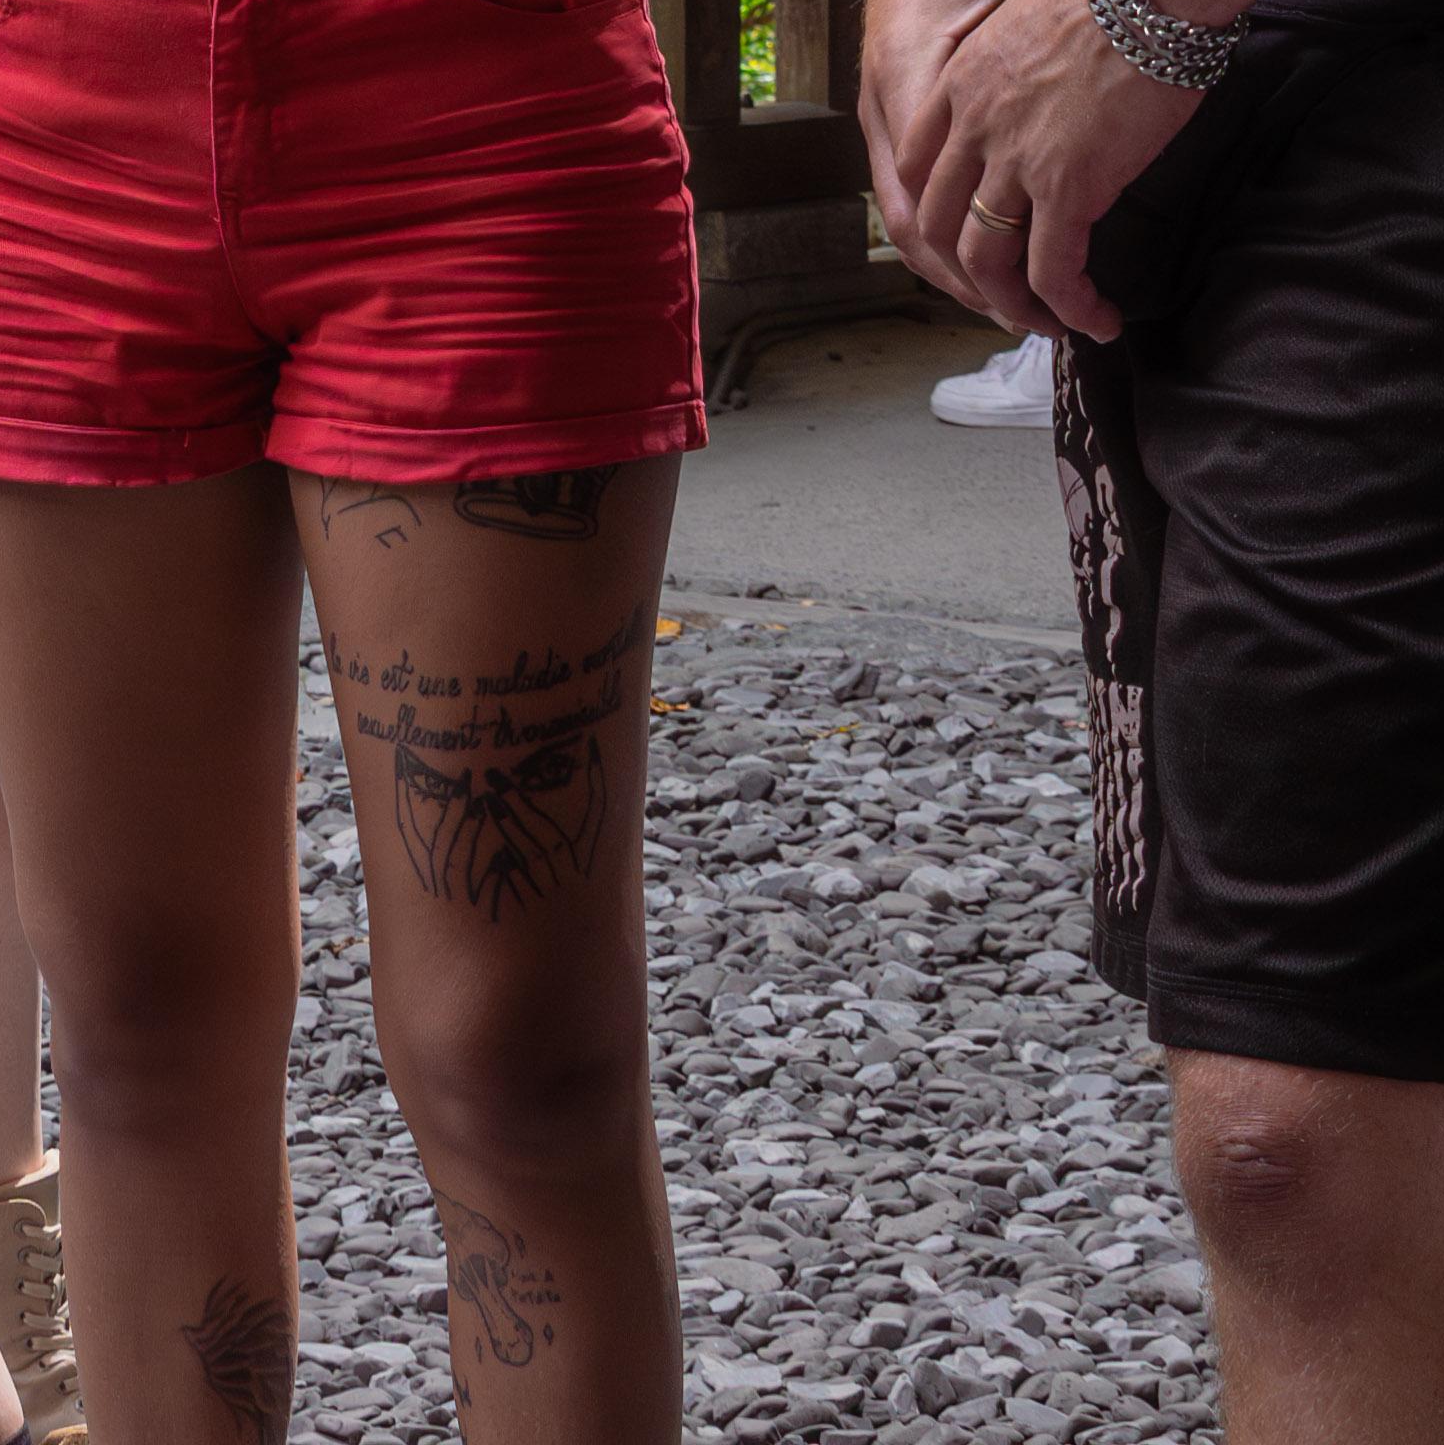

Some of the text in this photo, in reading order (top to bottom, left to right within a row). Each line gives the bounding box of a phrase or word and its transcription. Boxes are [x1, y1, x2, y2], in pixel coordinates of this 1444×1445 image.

[349, 652, 371, 685] vie
[380, 649, 414, 694] est
[417, 674, 462, 699] une
[474, 646, 573, 697] maladie
